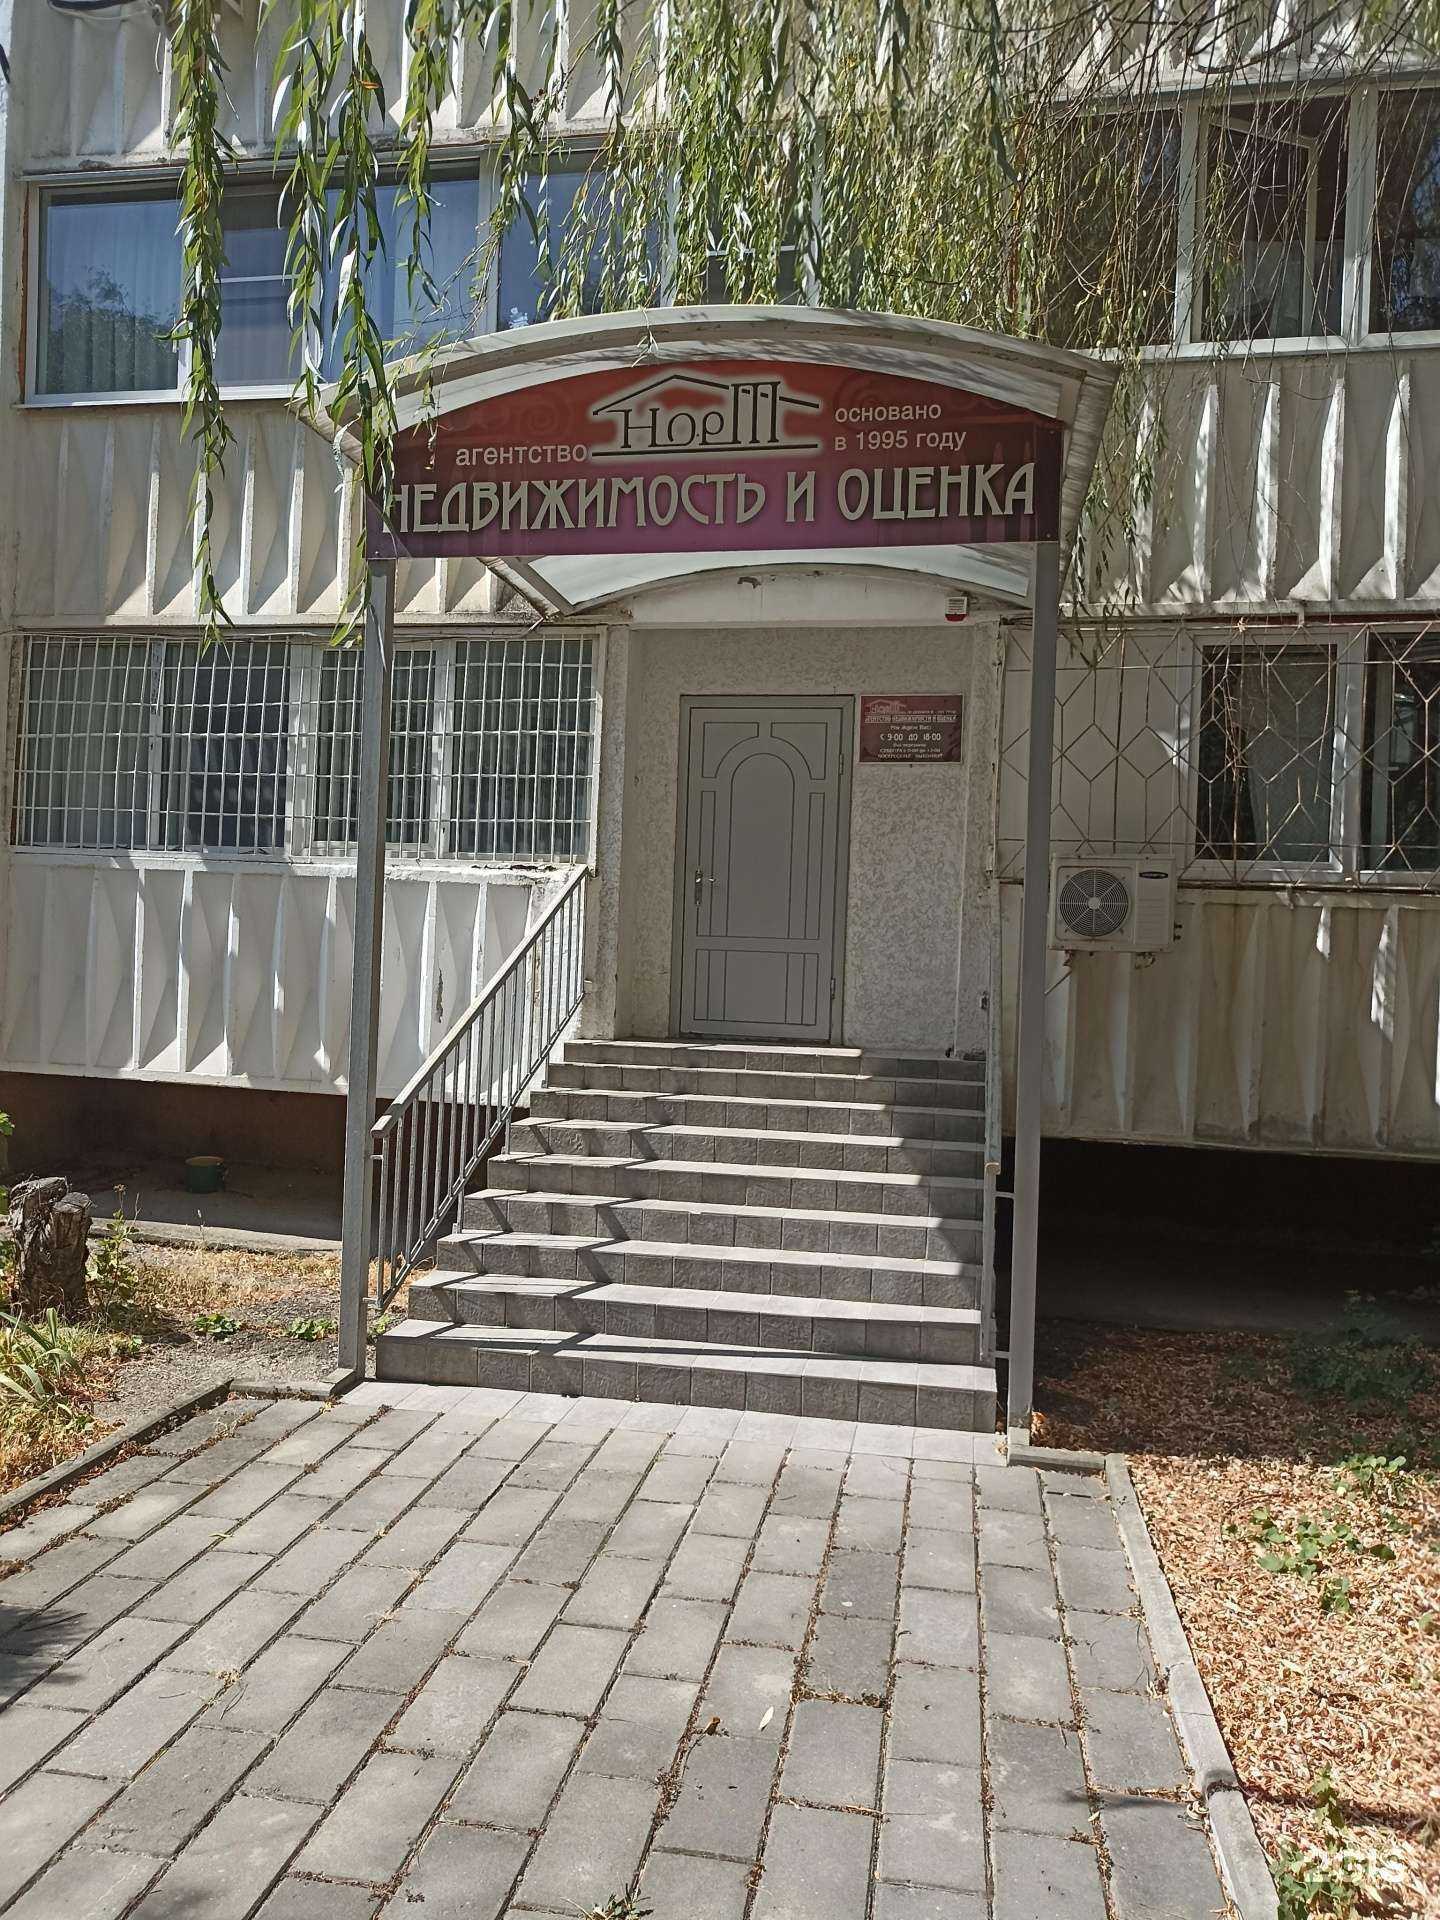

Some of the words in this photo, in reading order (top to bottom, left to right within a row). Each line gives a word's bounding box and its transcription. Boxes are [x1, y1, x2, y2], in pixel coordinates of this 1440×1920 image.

[834, 403, 942, 423] основано
[834, 435, 848, 451] в
[856, 430, 908, 450] 1995
[916, 431, 967, 451] году
[455, 444, 587, 466] агентство
[785, 470, 816, 523] И
[837, 462, 1035, 521] ОЦЕНКА
